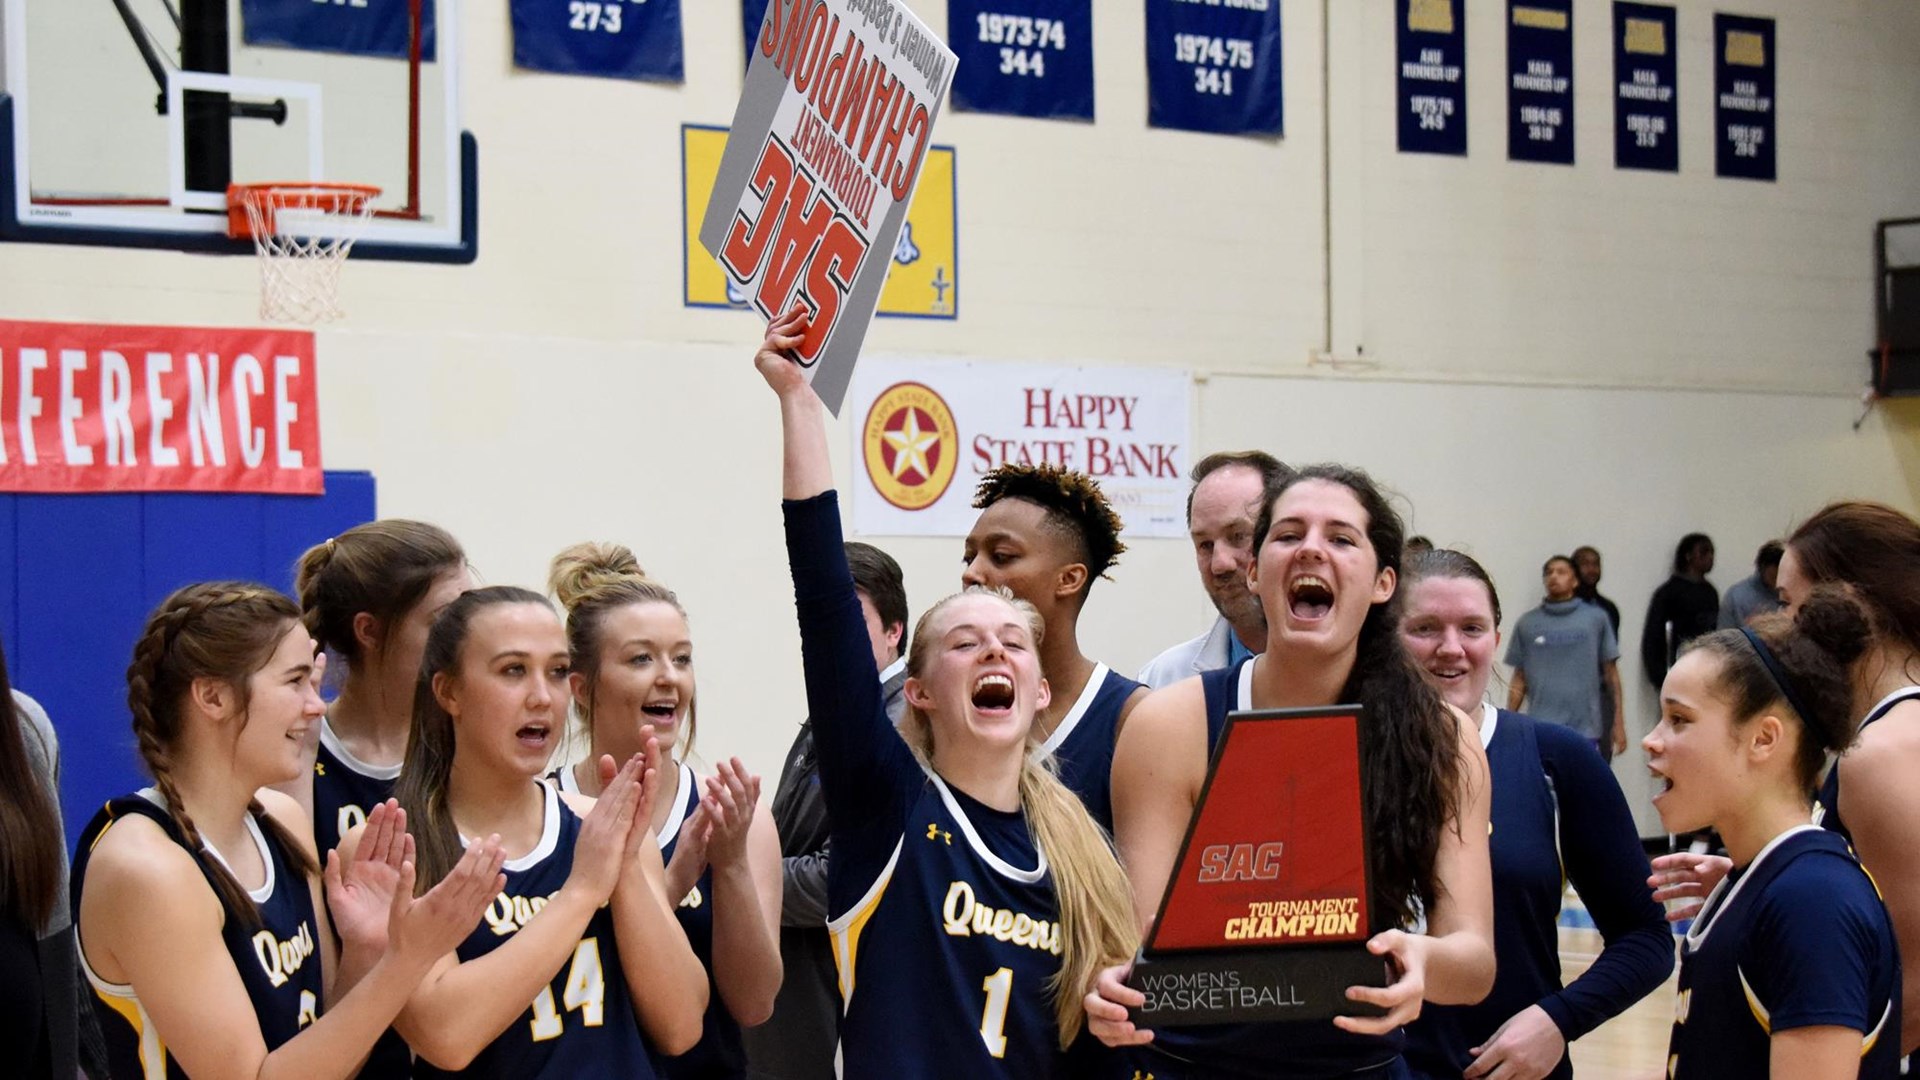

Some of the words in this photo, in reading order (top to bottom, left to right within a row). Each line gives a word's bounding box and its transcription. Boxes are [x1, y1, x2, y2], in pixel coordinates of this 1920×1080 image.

[569, 2, 622, 33] 27-3
[977, 12, 1066, 50] 1973-74
[889, 11, 947, 98] Women's
[1000, 48, 1044, 77] 34-4
[1174, 33, 1254, 69] 1974-75
[761, 0, 929, 202] CHAMPIONS
[1194, 67, 1233, 95] 34-1
[790, 104, 878, 230] TOURNAMENT
[719, 131, 870, 368] SAC
[0, 348, 303, 469] FERENCE
[1023, 387, 1138, 431] HAPPY
[971, 433, 1075, 476] STATE
[1085, 436, 1179, 479] BANK
[1198, 842, 1284, 883] SAC
[943, 880, 1062, 956] Queens
[1224, 912, 1359, 940] CHAMPION
[1249, 898, 1358, 918] TOURNAMENT
[530, 936, 605, 1042] 14
[1141, 985, 1305, 1013] BASKETBALL
[1142, 970, 1241, 991] WOMEN'S
[979, 966, 1013, 1059] 1
